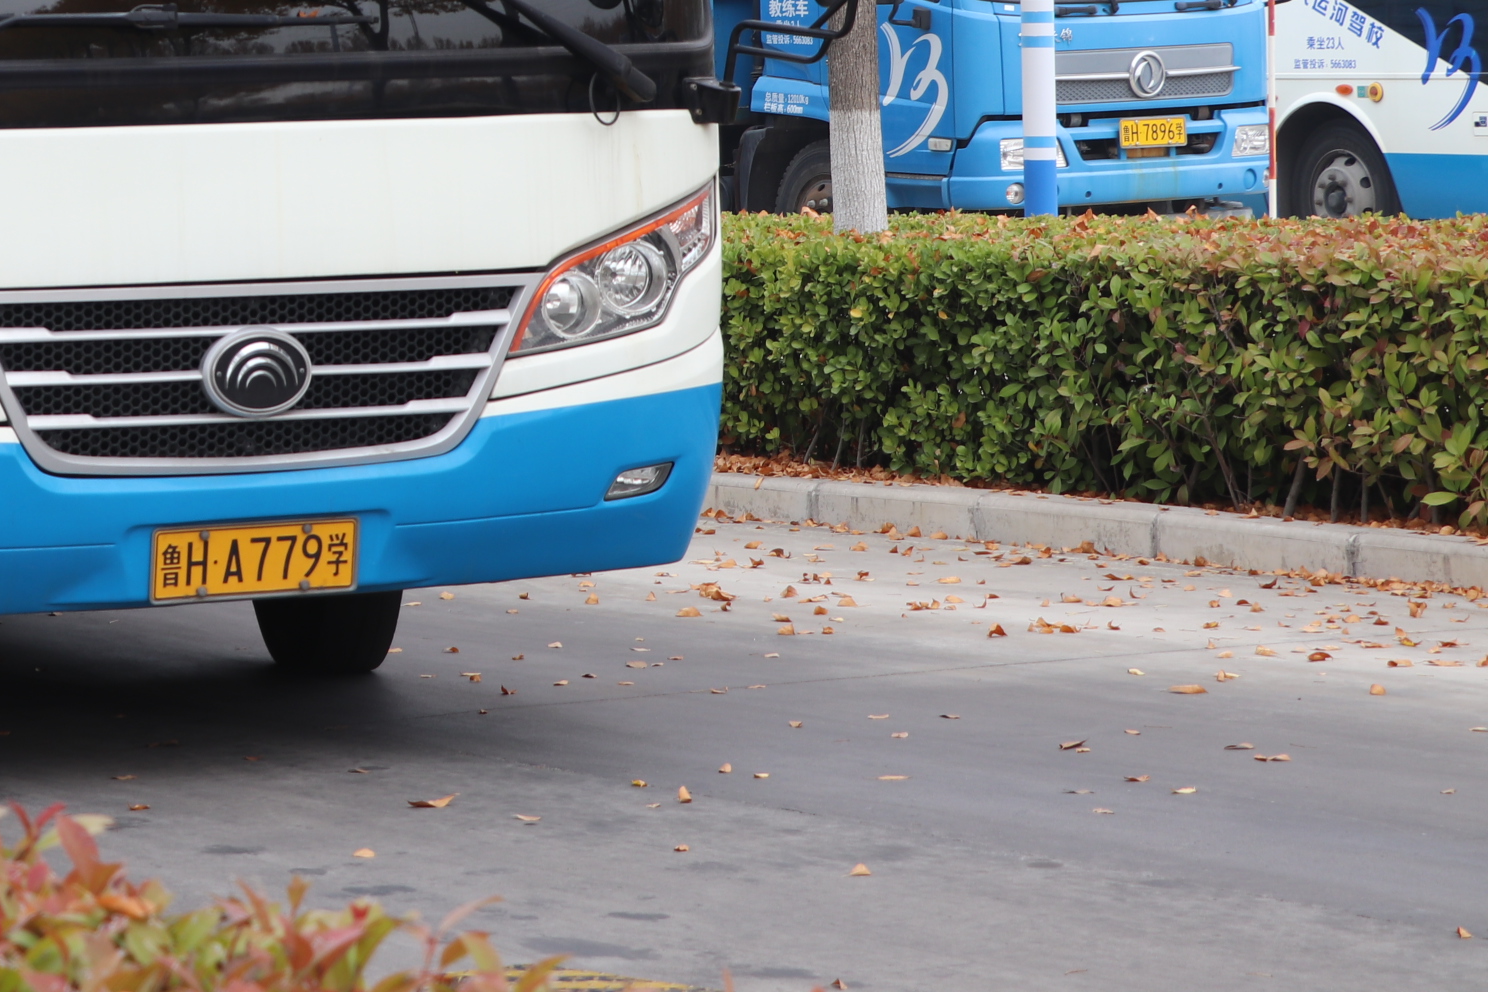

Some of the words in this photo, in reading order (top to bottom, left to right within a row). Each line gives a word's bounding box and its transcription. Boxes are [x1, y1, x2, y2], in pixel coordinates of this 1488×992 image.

[1306, 36, 1345, 50] 乘坐23人
[160, 532, 349, 588] 鲁H·A779学
